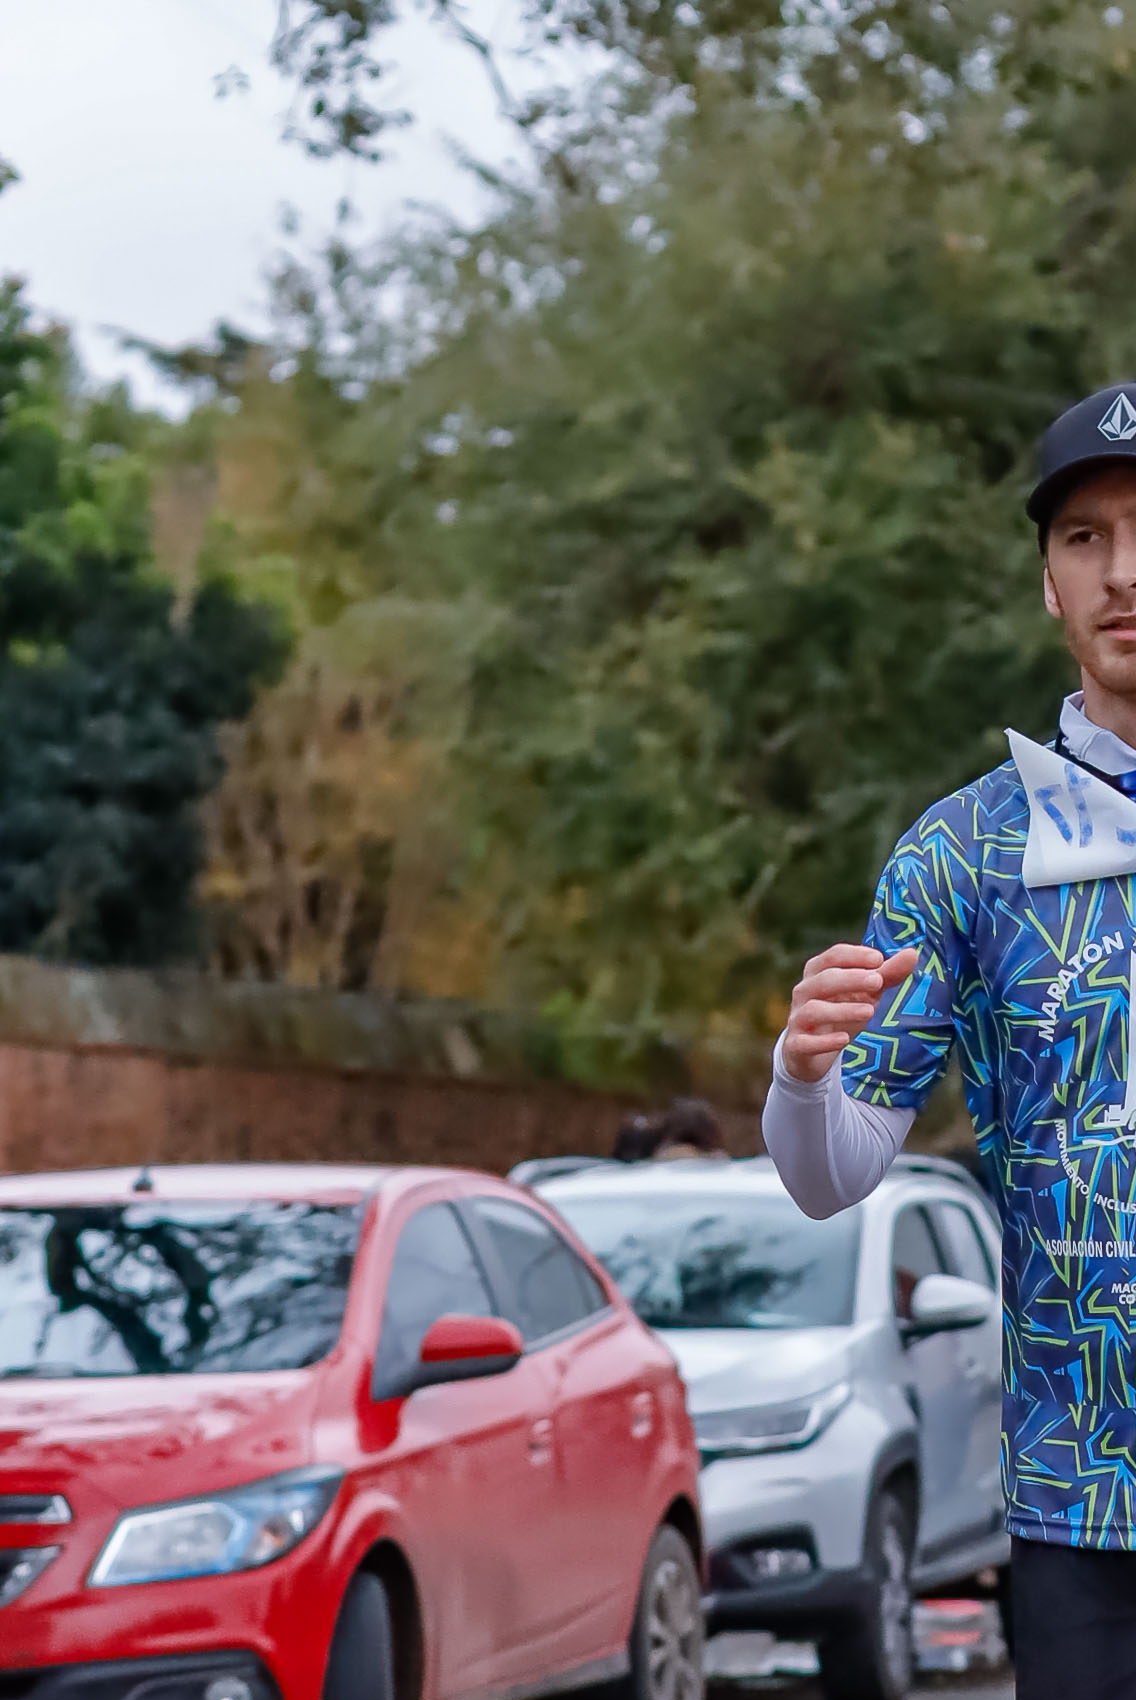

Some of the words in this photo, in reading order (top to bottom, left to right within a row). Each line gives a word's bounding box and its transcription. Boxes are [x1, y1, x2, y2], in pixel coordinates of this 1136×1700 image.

[1038, 931, 1125, 1043] MARATÓN
[1046, 1236, 1104, 1258] ASOCIACIÓN
[1105, 1240, 1136, 1258] CIVIL
